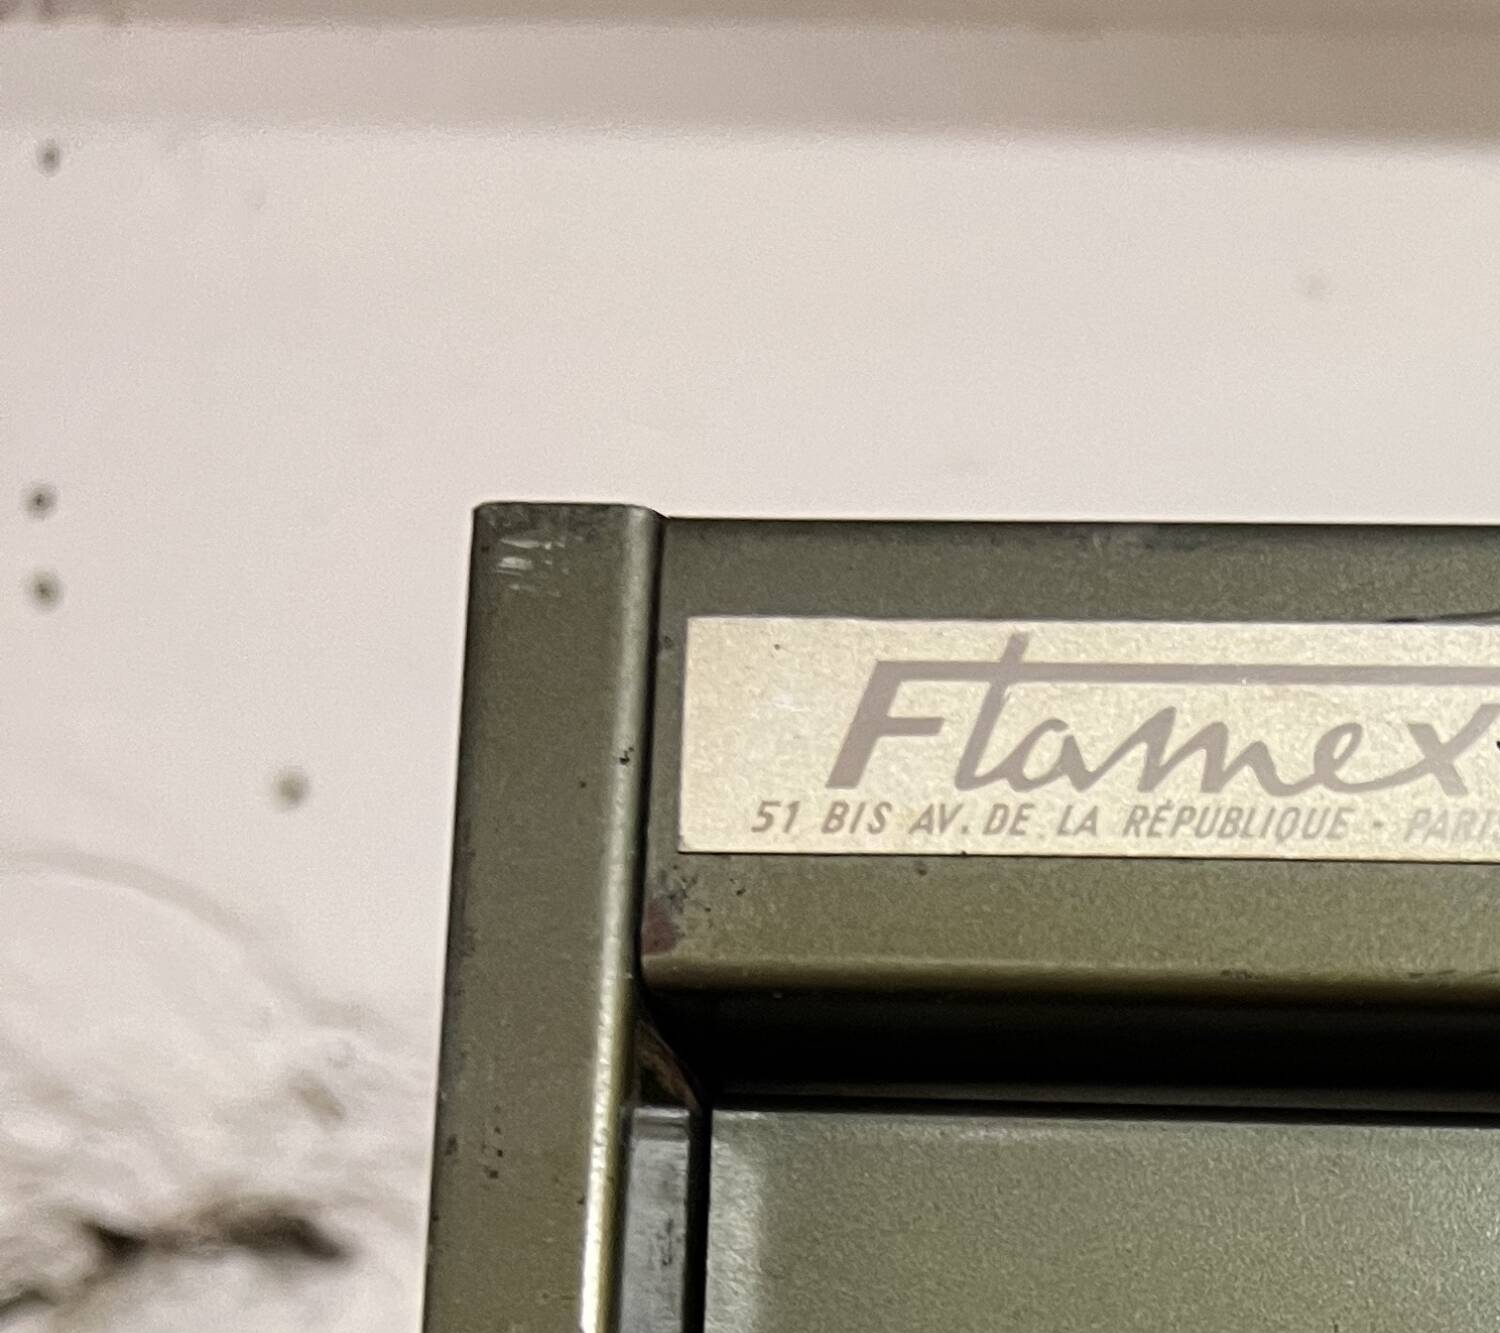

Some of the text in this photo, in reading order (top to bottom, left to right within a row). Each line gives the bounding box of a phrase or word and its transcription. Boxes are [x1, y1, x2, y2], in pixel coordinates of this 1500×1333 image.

[750, 800, 800, 832] 51
[820, 800, 893, 834] BIS
[907, 802, 968, 835] AV.
[981, 803, 1035, 835] DE
[1056, 803, 1099, 836] LA
[1122, 800, 1354, 842] RÉPUBLIQUE
